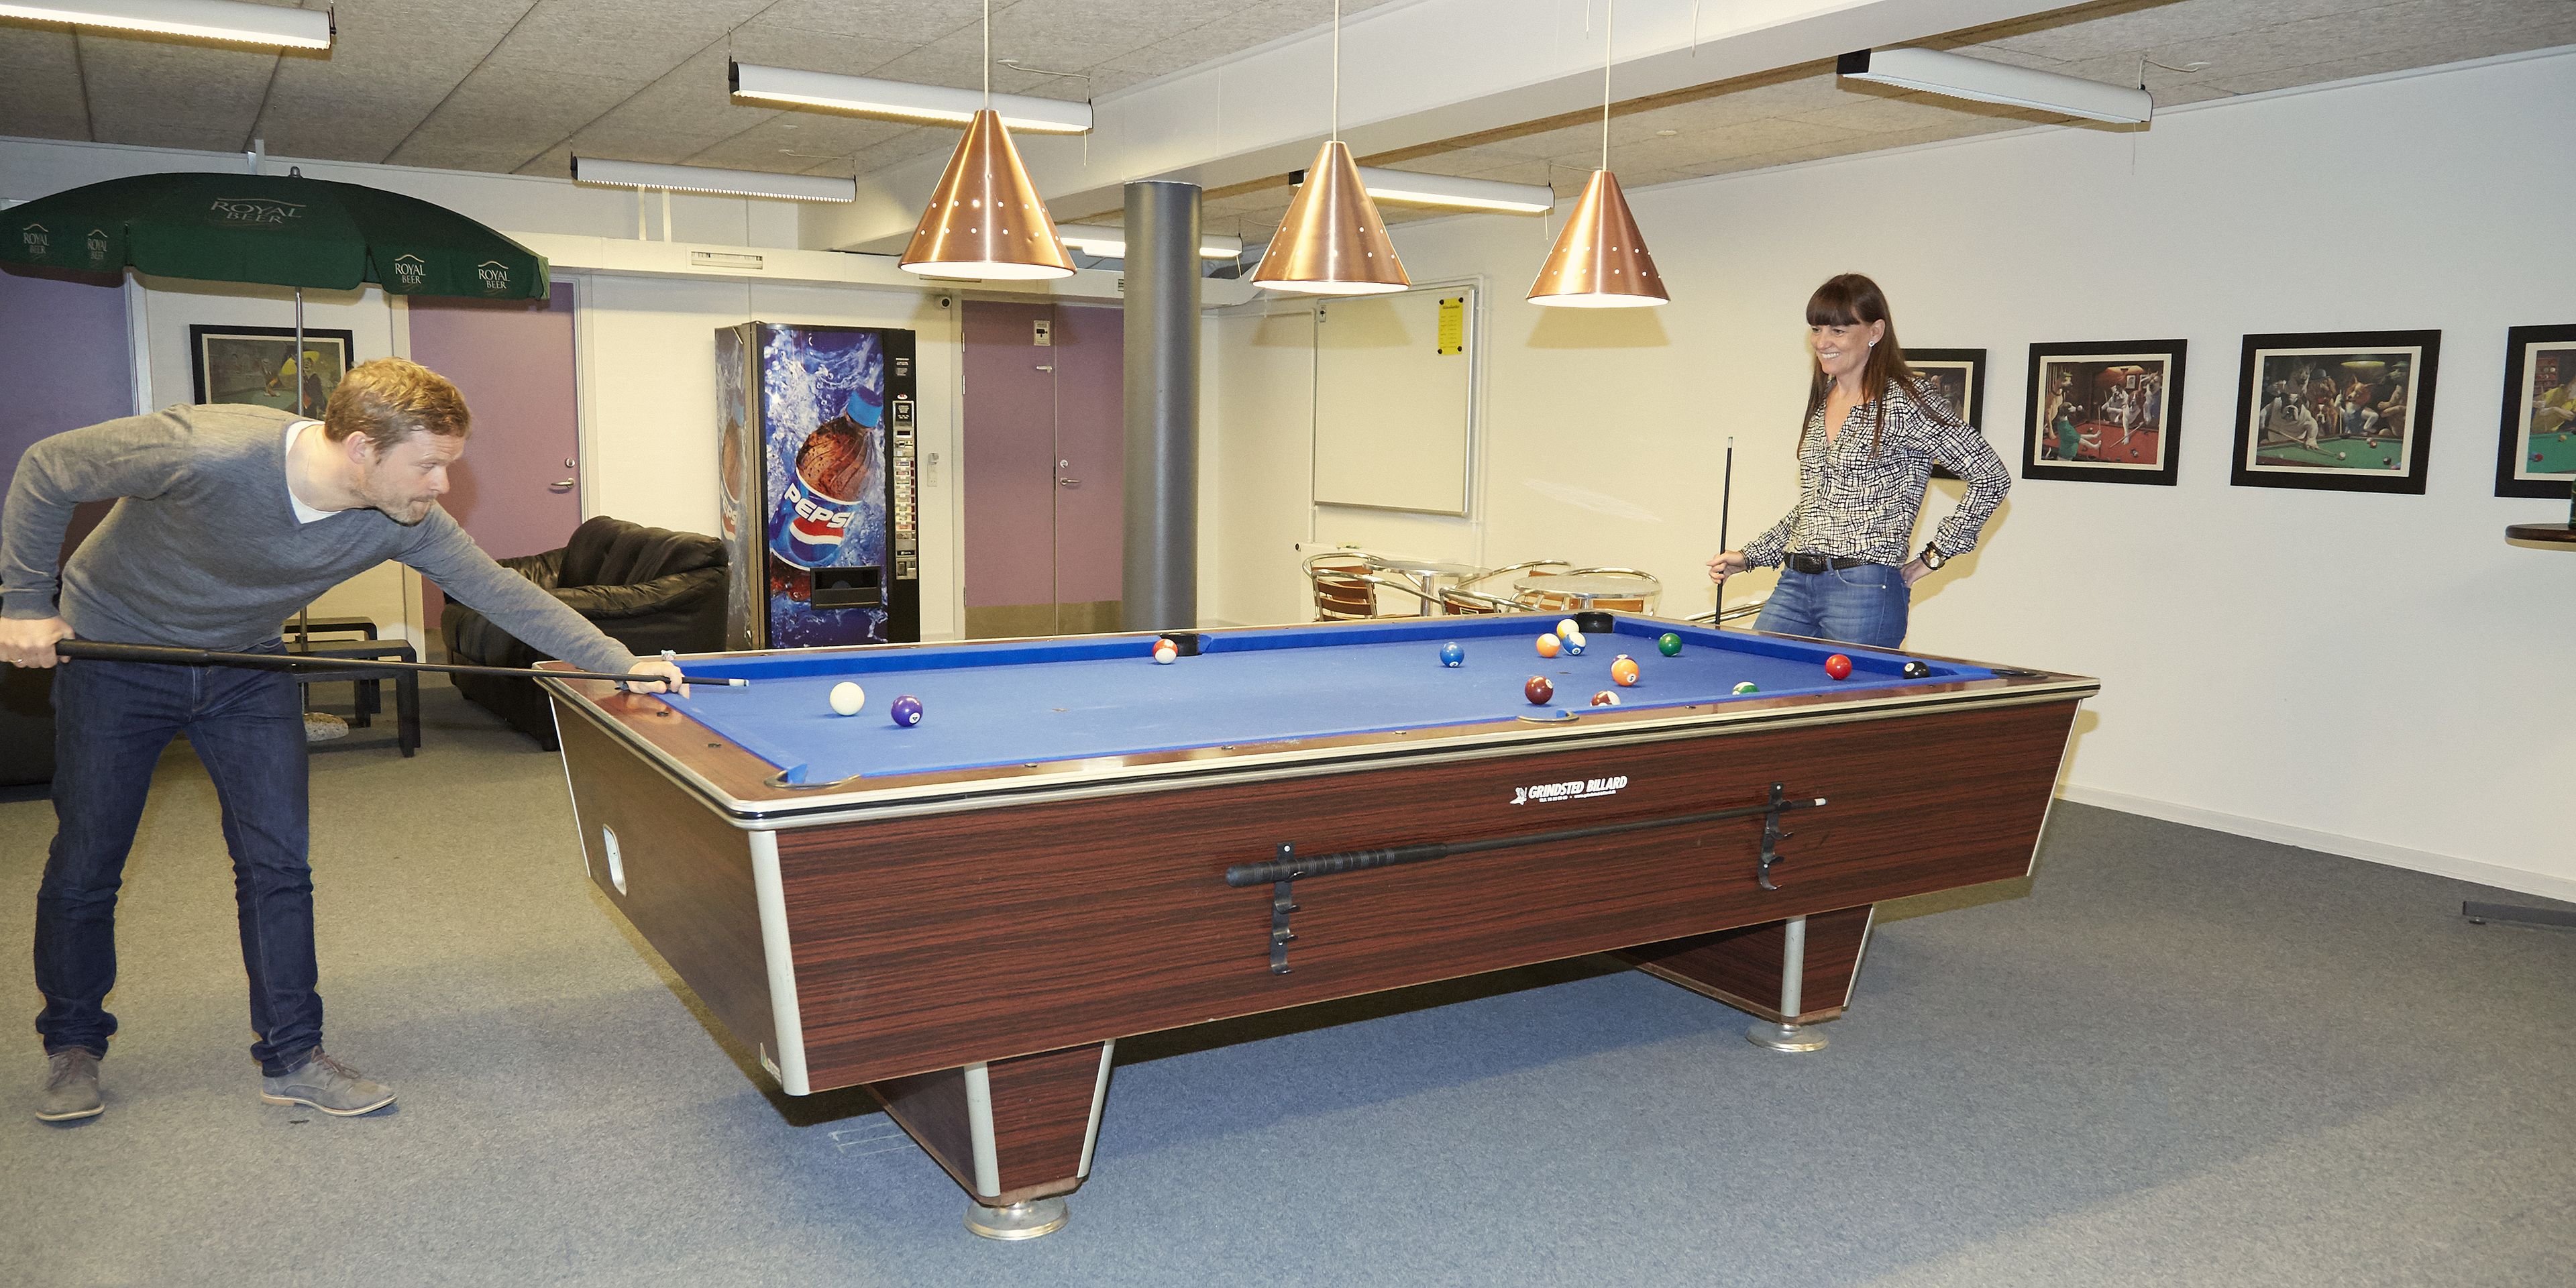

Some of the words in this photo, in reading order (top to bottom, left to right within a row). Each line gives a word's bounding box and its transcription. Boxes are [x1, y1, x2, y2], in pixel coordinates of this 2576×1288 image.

[211, 201, 302, 218] ROYAL
[227, 212, 284, 224] BEER
[23, 232, 50, 246] ROYAL
[87, 238, 107, 252] ROYAL
[395, 263, 426, 276] ROYAL
[478, 269, 511, 282] ROYAL
[402, 275, 421, 284] BEER
[486, 280, 506, 289] BEER
[784, 482, 855, 529] PEPSI
[1528, 781, 1585, 799] GRINDSTED
[1586, 775, 1628, 792] BILLARD
